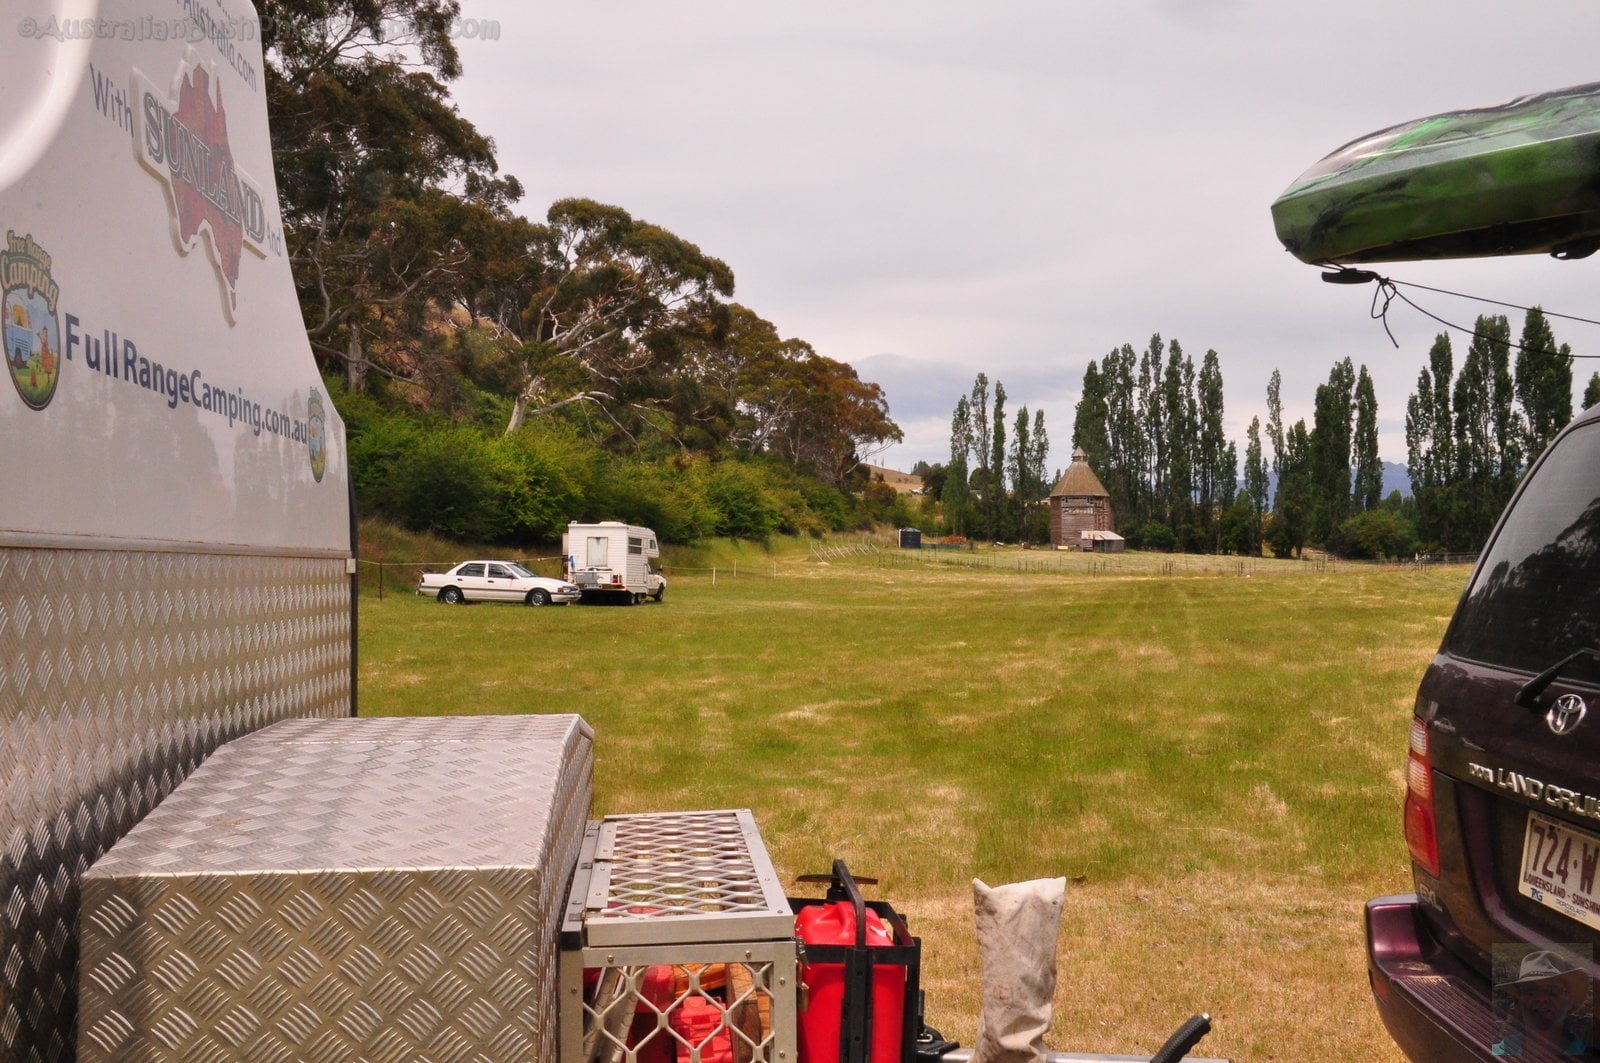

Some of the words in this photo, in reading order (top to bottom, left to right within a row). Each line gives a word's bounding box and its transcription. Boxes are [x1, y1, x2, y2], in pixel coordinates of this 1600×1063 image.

[89, 62, 134, 137] With
[144, 92, 265, 244] SUNLAND
[1, 251, 58, 314] Camping
[65, 312, 308, 445] FullRangeCamping.com.au
